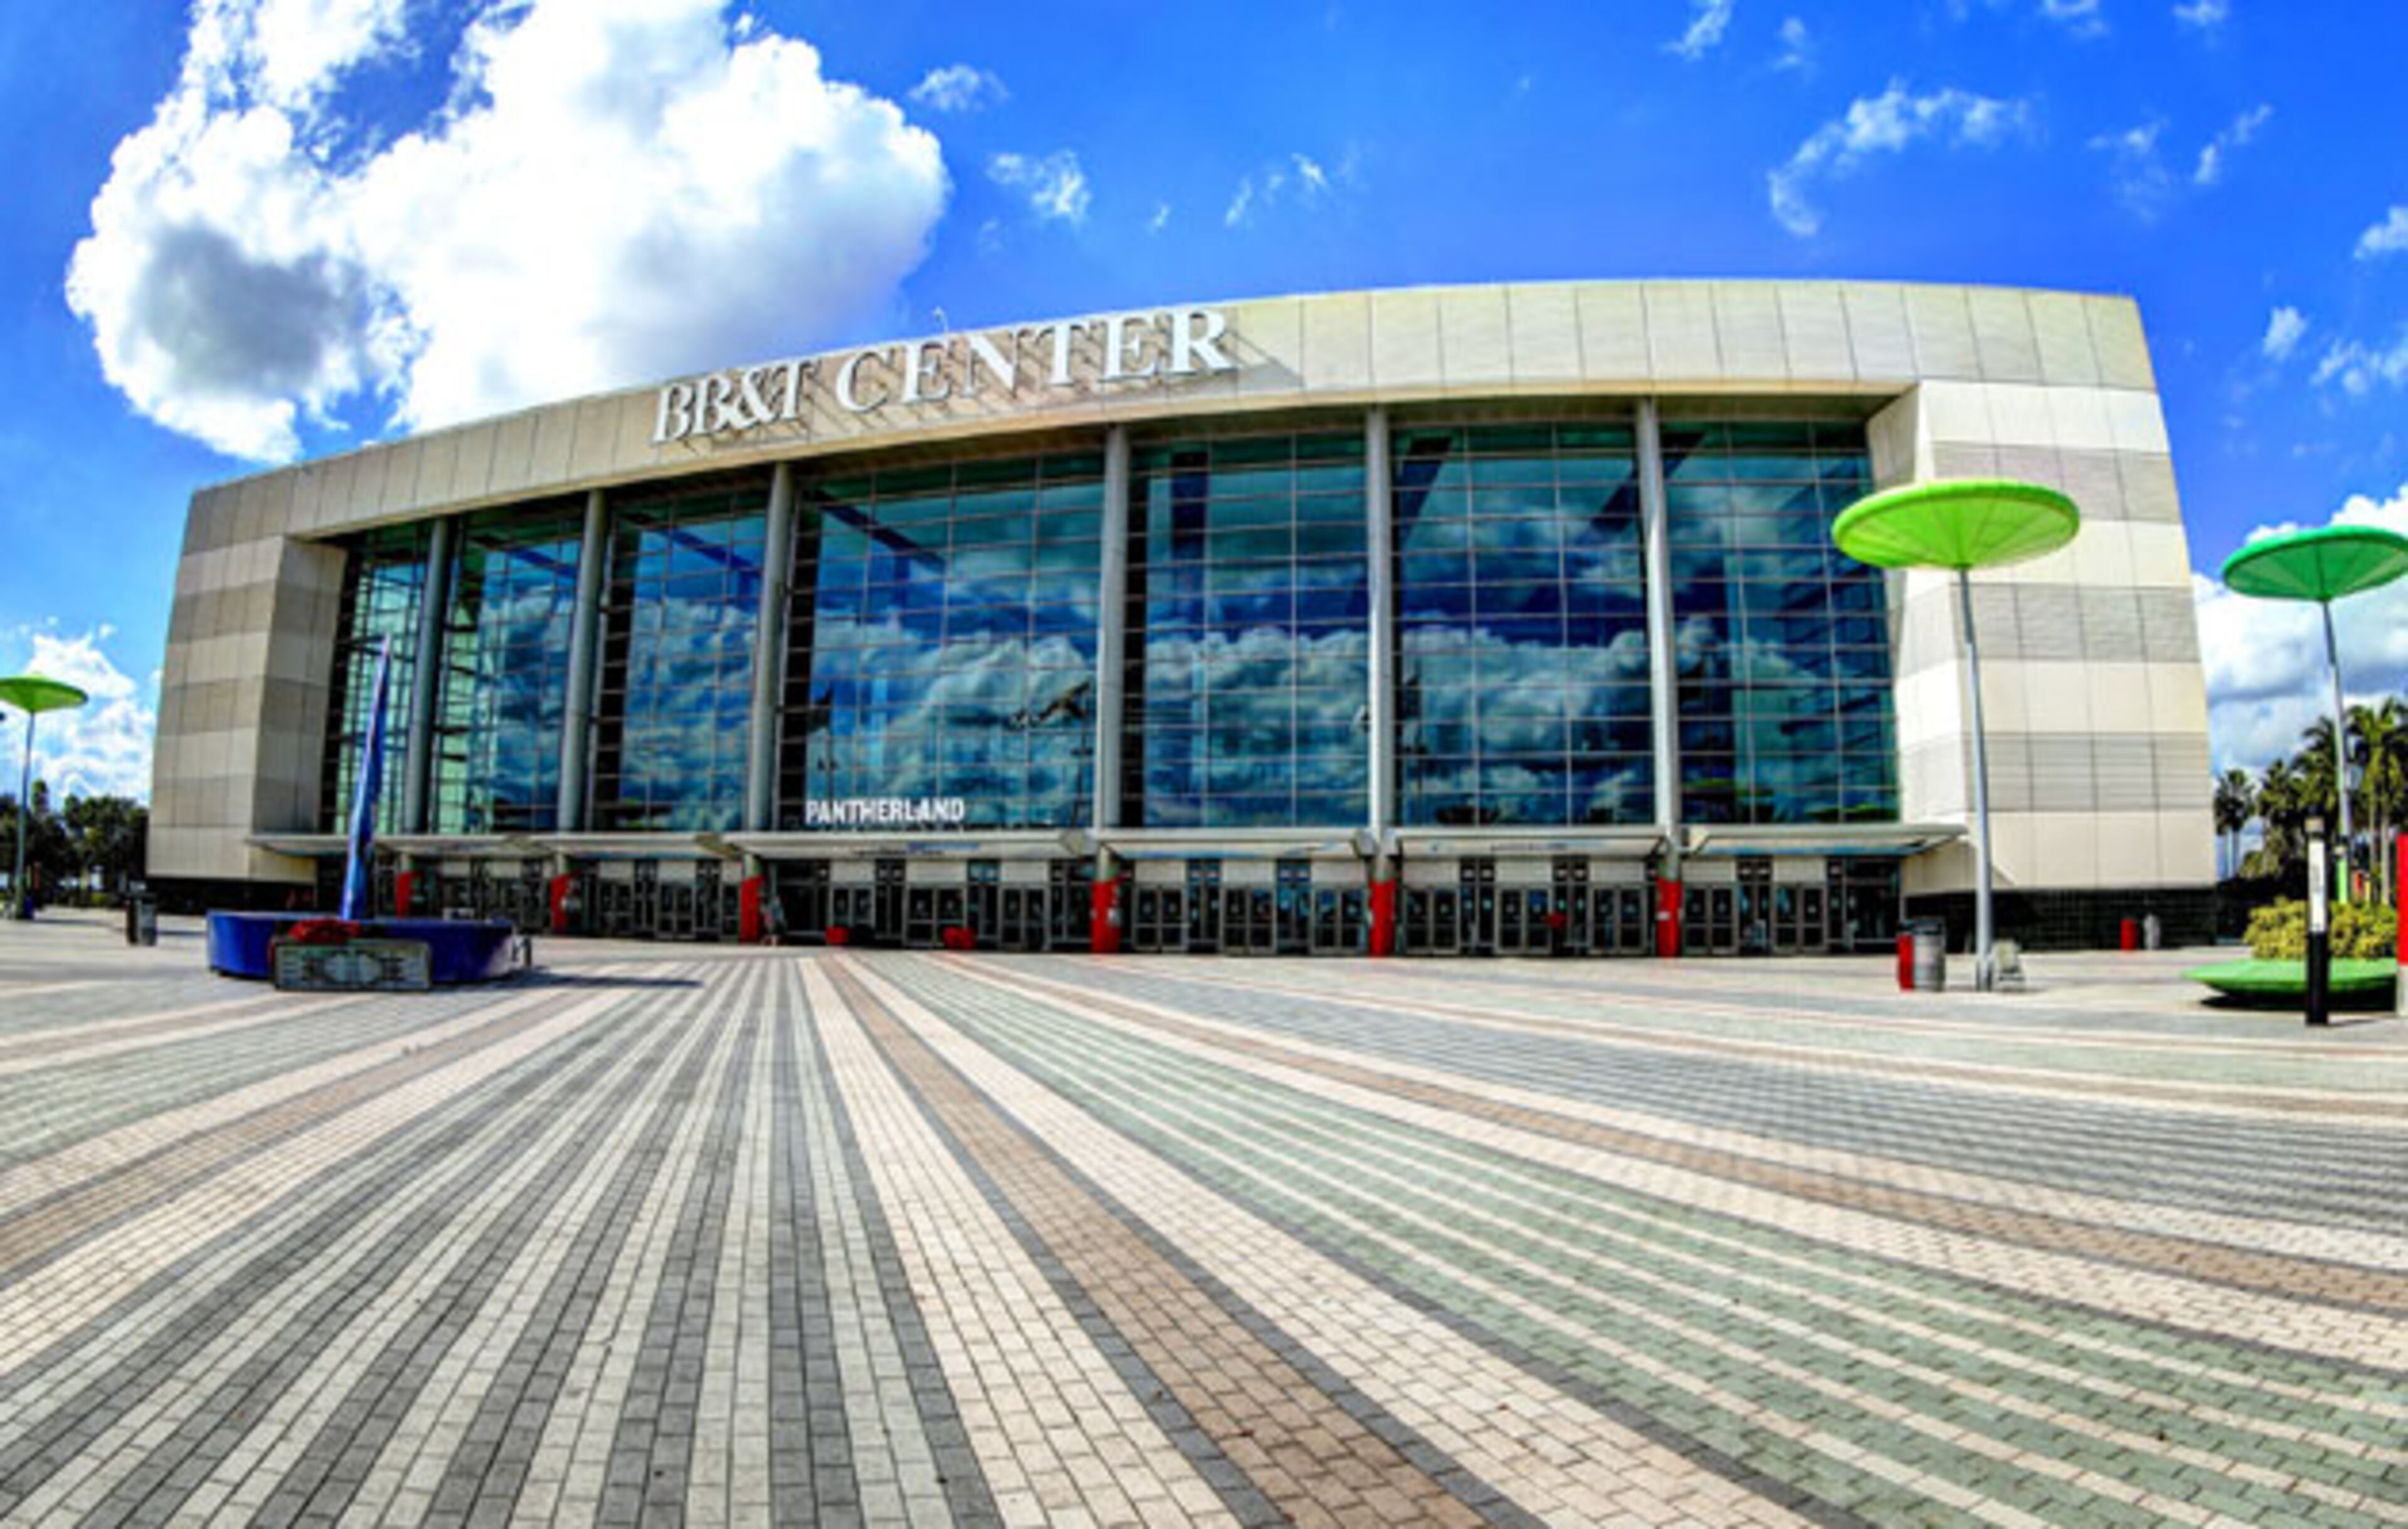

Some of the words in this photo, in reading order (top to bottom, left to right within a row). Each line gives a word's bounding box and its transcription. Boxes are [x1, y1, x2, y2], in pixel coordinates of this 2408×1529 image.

[653, 361, 815, 442] BB&T
[837, 309, 1234, 412] CENTER
[806, 797, 964, 823] PANTHERLAND
